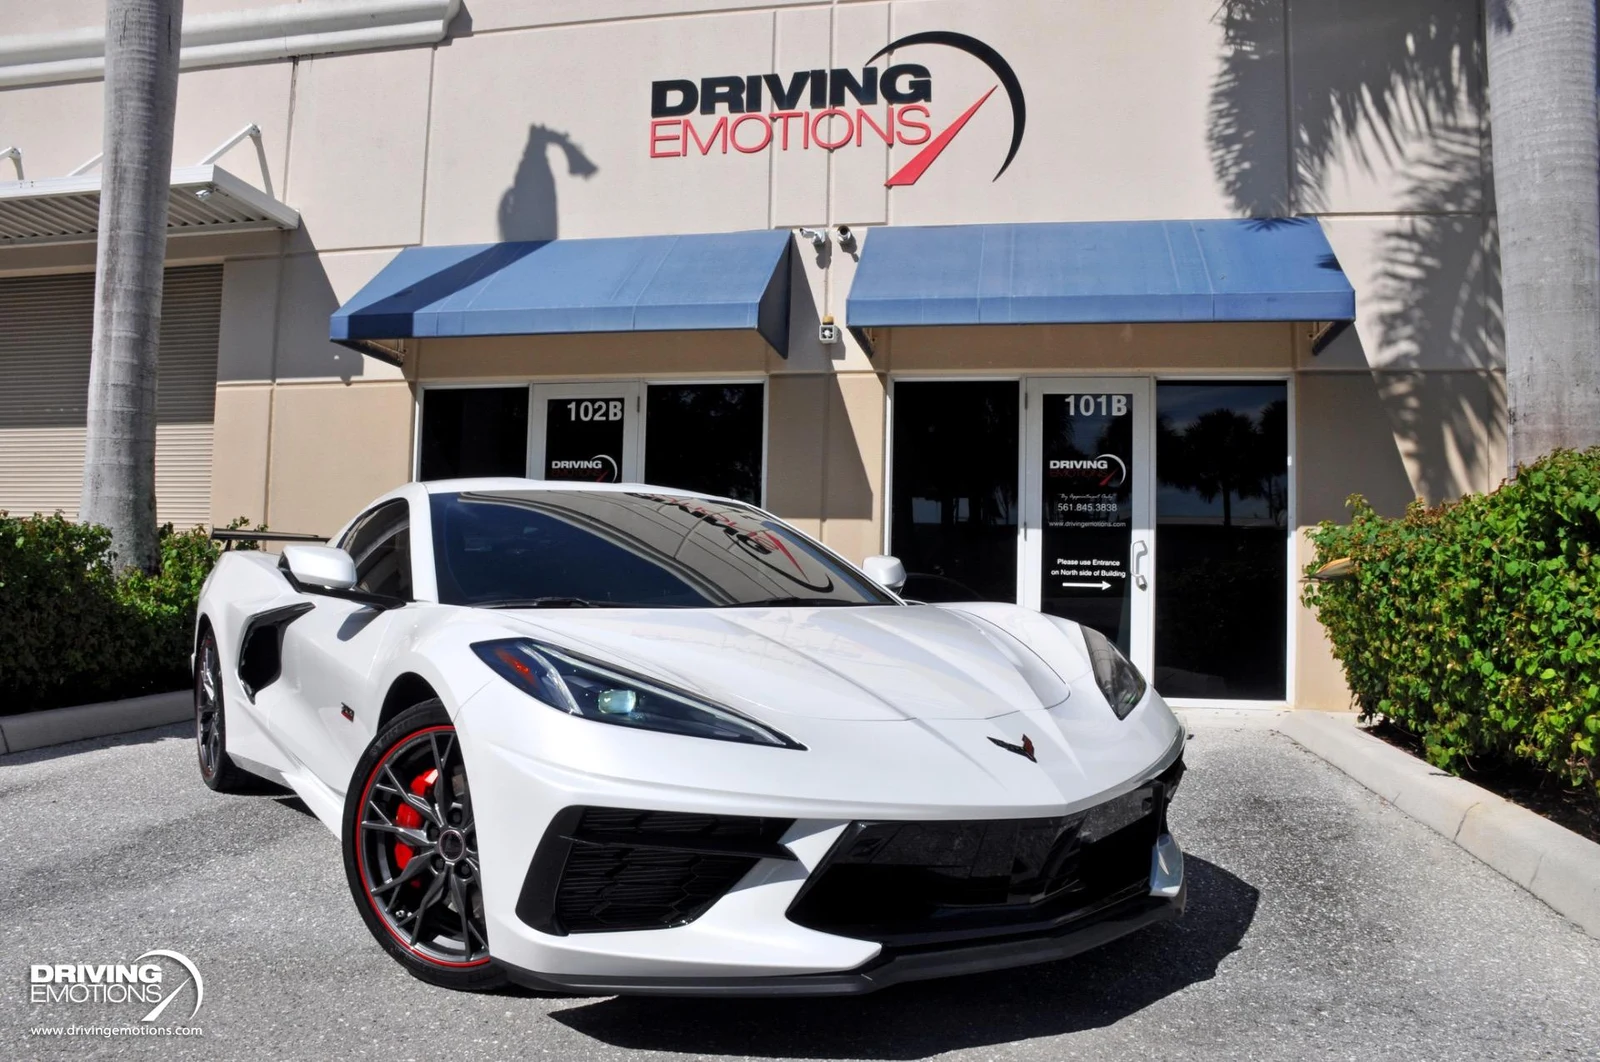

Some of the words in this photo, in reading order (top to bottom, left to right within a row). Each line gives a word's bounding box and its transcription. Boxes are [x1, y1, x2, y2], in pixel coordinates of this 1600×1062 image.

[651, 63, 932, 118] DRIVING
[650, 105, 932, 158] EMOTIONS
[1065, 395, 1127, 416] 101B
[567, 401, 622, 421] 102B
[551, 460, 602, 469] DRIVING
[1049, 460, 1108, 469] DRIVING
[1057, 503, 1118, 512] 561.845.3838
[1048, 520, 1126, 528] www.drivingemotions.com
[1101, 570, 1126, 578] Building
